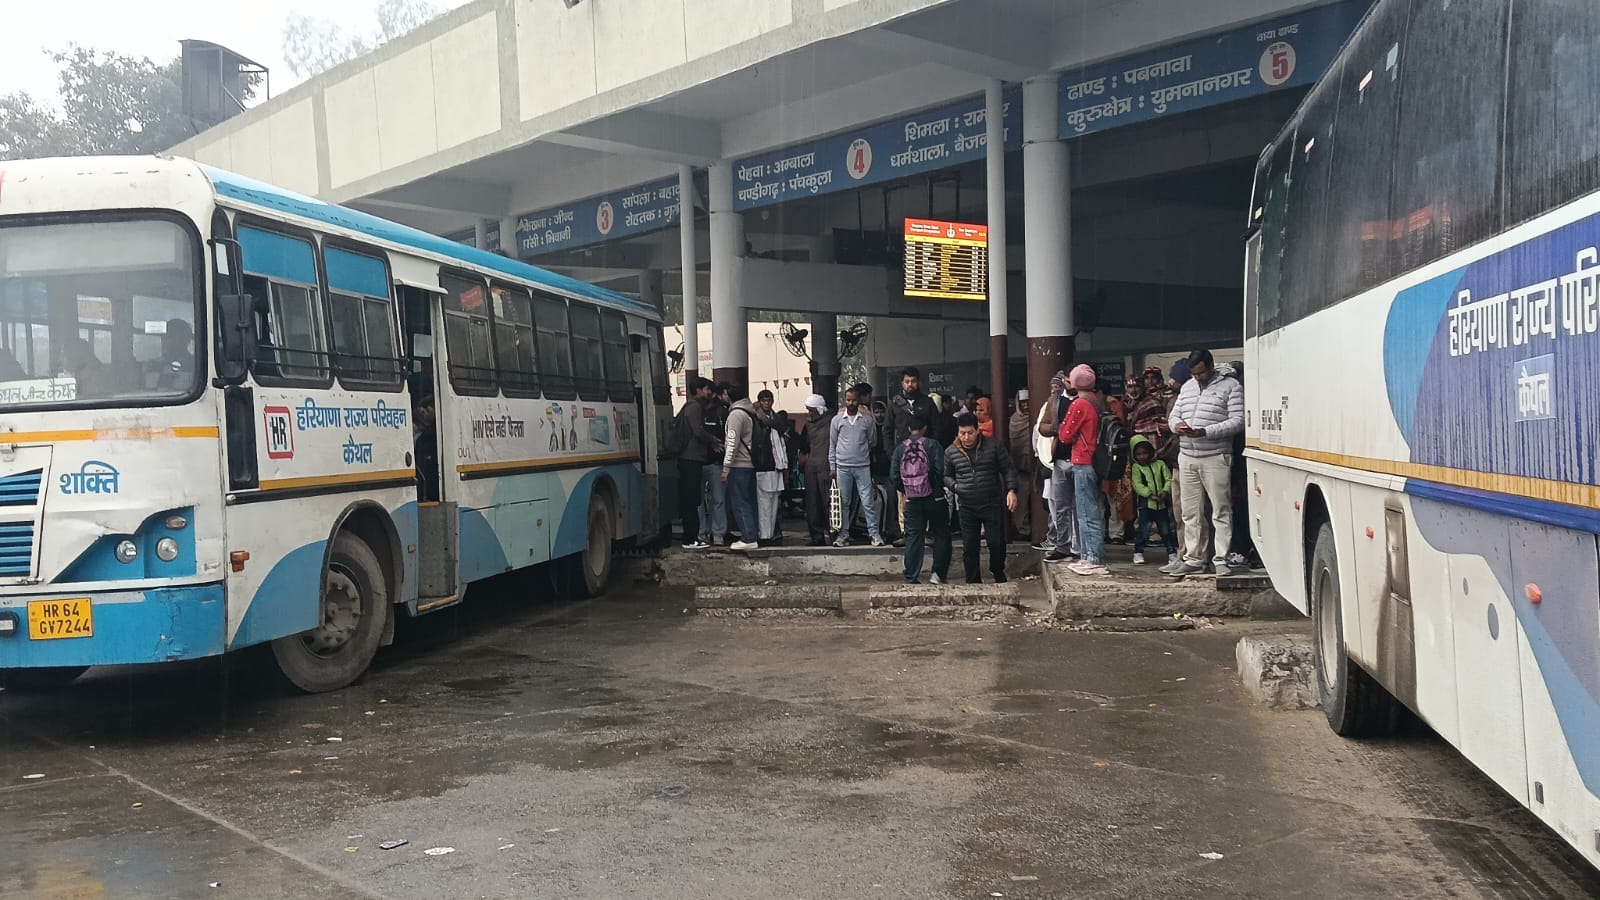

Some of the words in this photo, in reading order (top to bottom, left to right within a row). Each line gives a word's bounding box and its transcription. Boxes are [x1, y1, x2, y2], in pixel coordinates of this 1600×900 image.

[1272, 51, 1289, 80] 5
[1067, 77, 1106, 101] ढाण्ड
[1066, 96, 1133, 132] कुरुक्षेत्र
[904, 121, 951, 142] शिमला
[738, 165, 764, 182] पेहवा
[854, 149, 865, 174] 4
[789, 170, 833, 194] पंचकुला
[601, 209, 609, 231] 3
[625, 209, 657, 227] रोहतक
[1448, 288, 1509, 357] हरियाणा
[1510, 278, 1558, 346] राज्य
[1560, 246, 1600, 336] परि
[296, 397, 341, 431] हरियाणा
[343, 407, 369, 428] राज्य
[370, 399, 407, 430] परिवहन
[270, 416, 288, 451] HR
[342, 434, 373, 465] कैथल
[59, 460, 120, 494] शक्ति
[43, 604, 60, 618] HR
[63, 602, 80, 617] 64
[39, 618, 91, 635] GV7244
